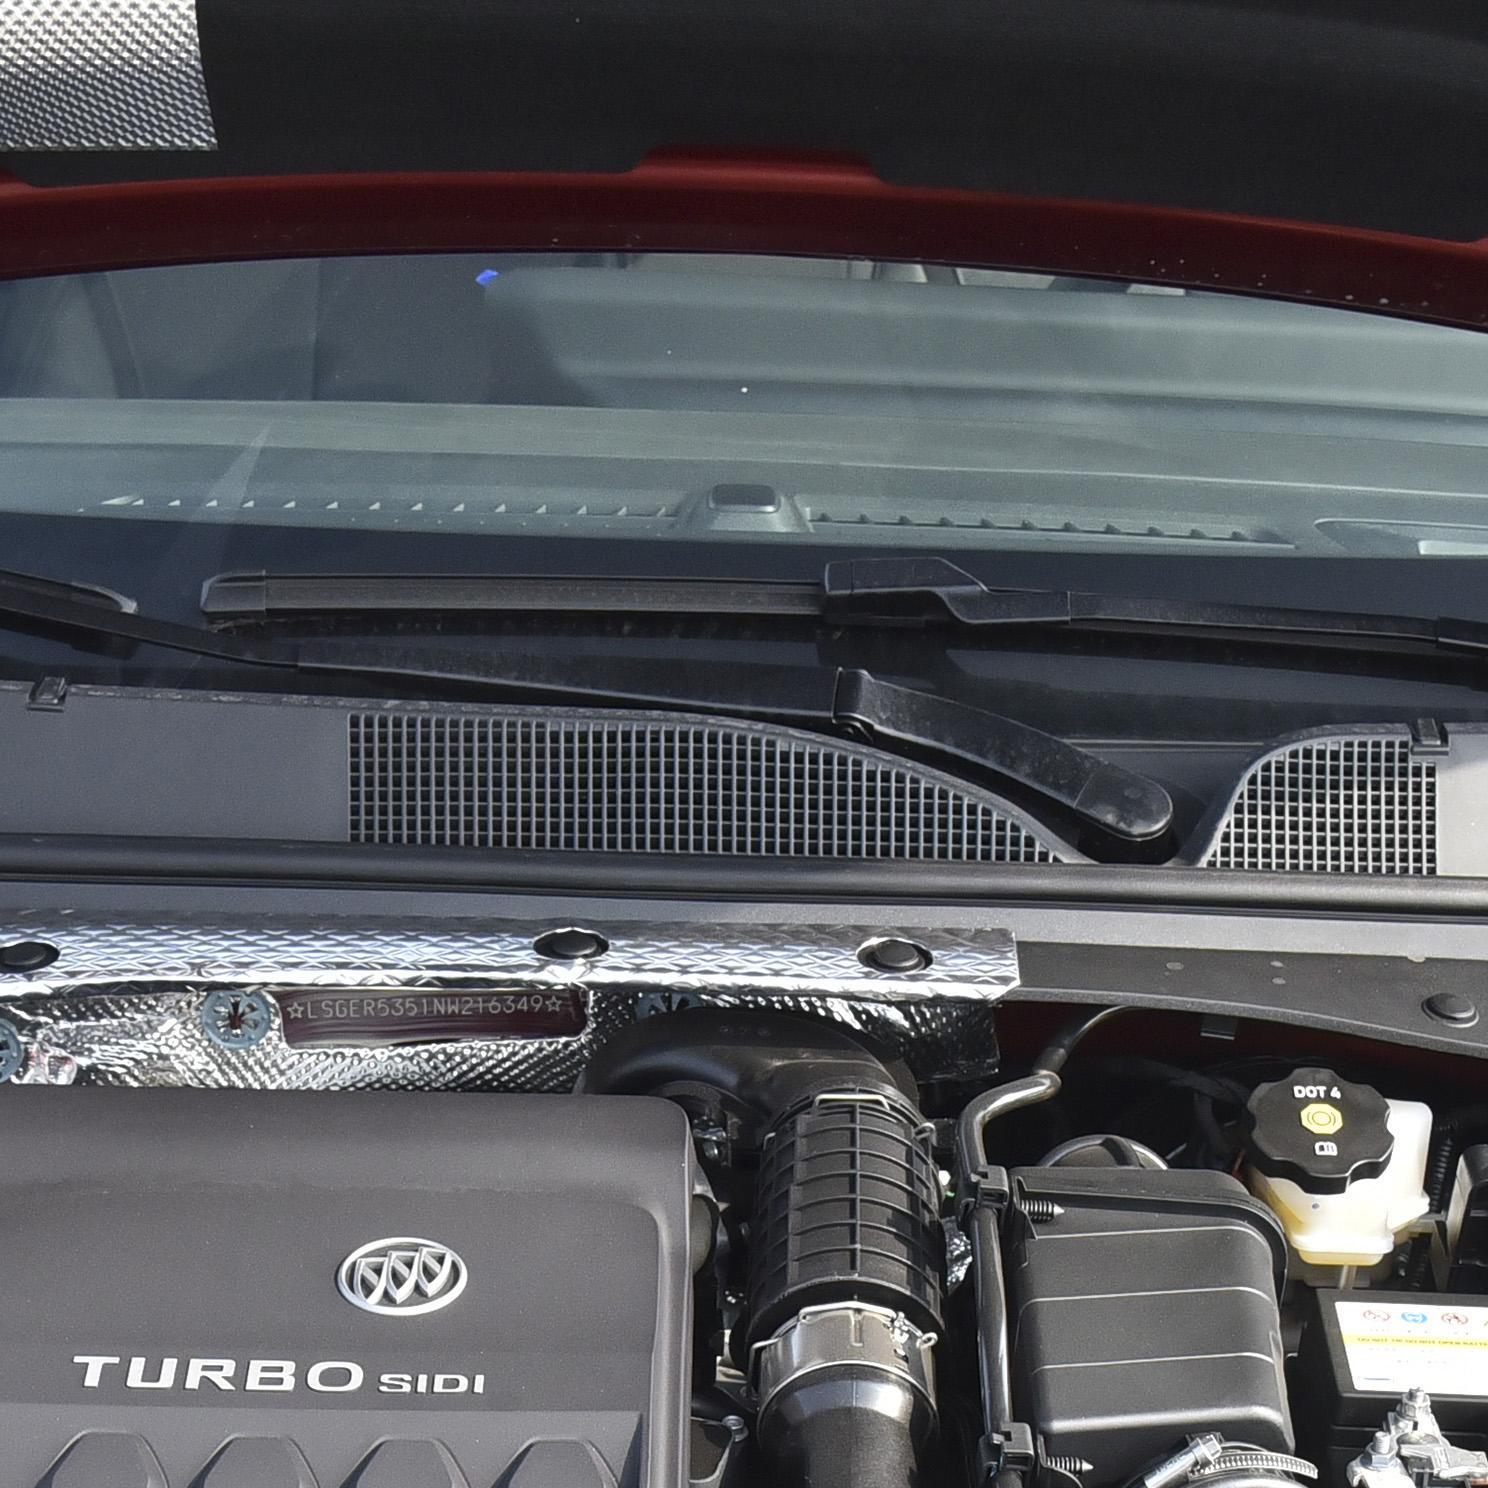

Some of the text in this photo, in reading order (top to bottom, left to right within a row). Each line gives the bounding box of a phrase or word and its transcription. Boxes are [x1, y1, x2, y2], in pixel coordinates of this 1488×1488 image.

[1293, 1085, 1342, 1100] DOT 4
[72, 1355, 485, 1395] TURBO SIDI
